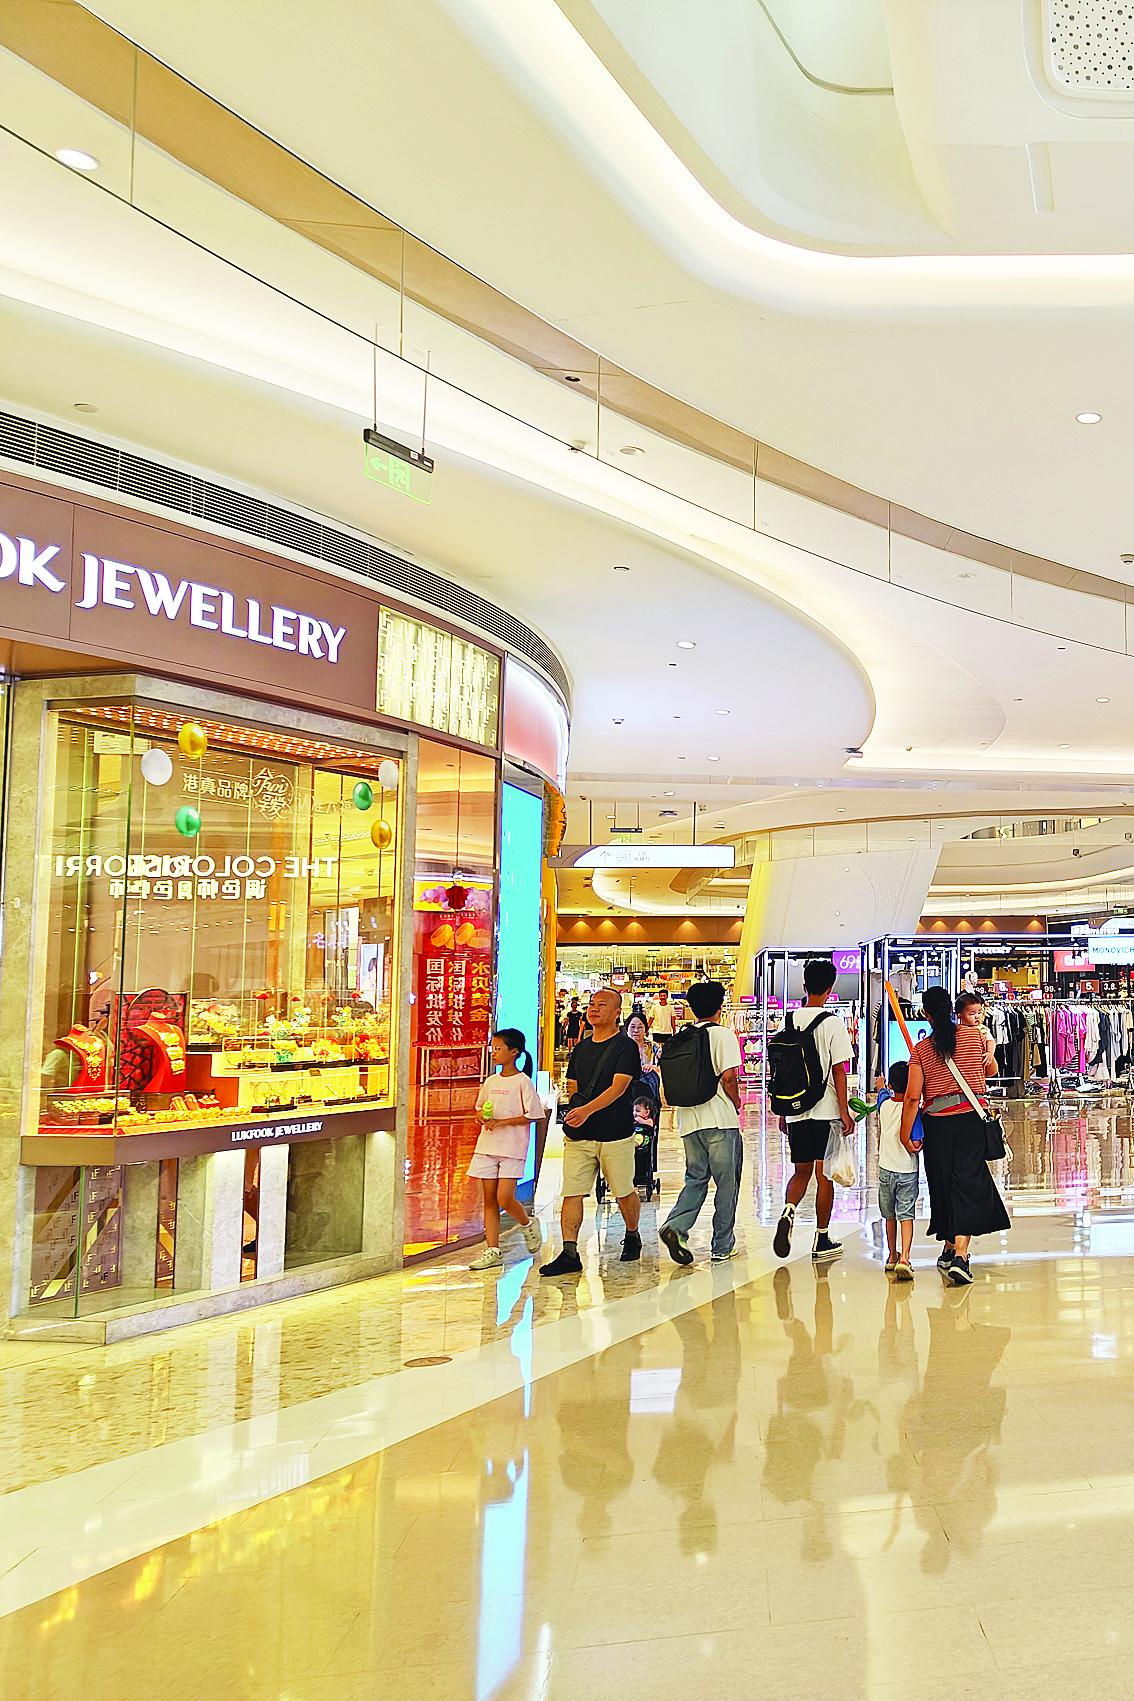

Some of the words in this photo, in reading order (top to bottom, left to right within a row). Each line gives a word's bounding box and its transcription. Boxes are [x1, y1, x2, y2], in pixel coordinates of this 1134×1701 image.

[75, 552, 347, 664] JEWELLERY
[182, 772, 250, 801] 港真品牌
[231, 1127, 274, 1142] LUKFOOK
[275, 1122, 323, 1138] JEWELLERY
